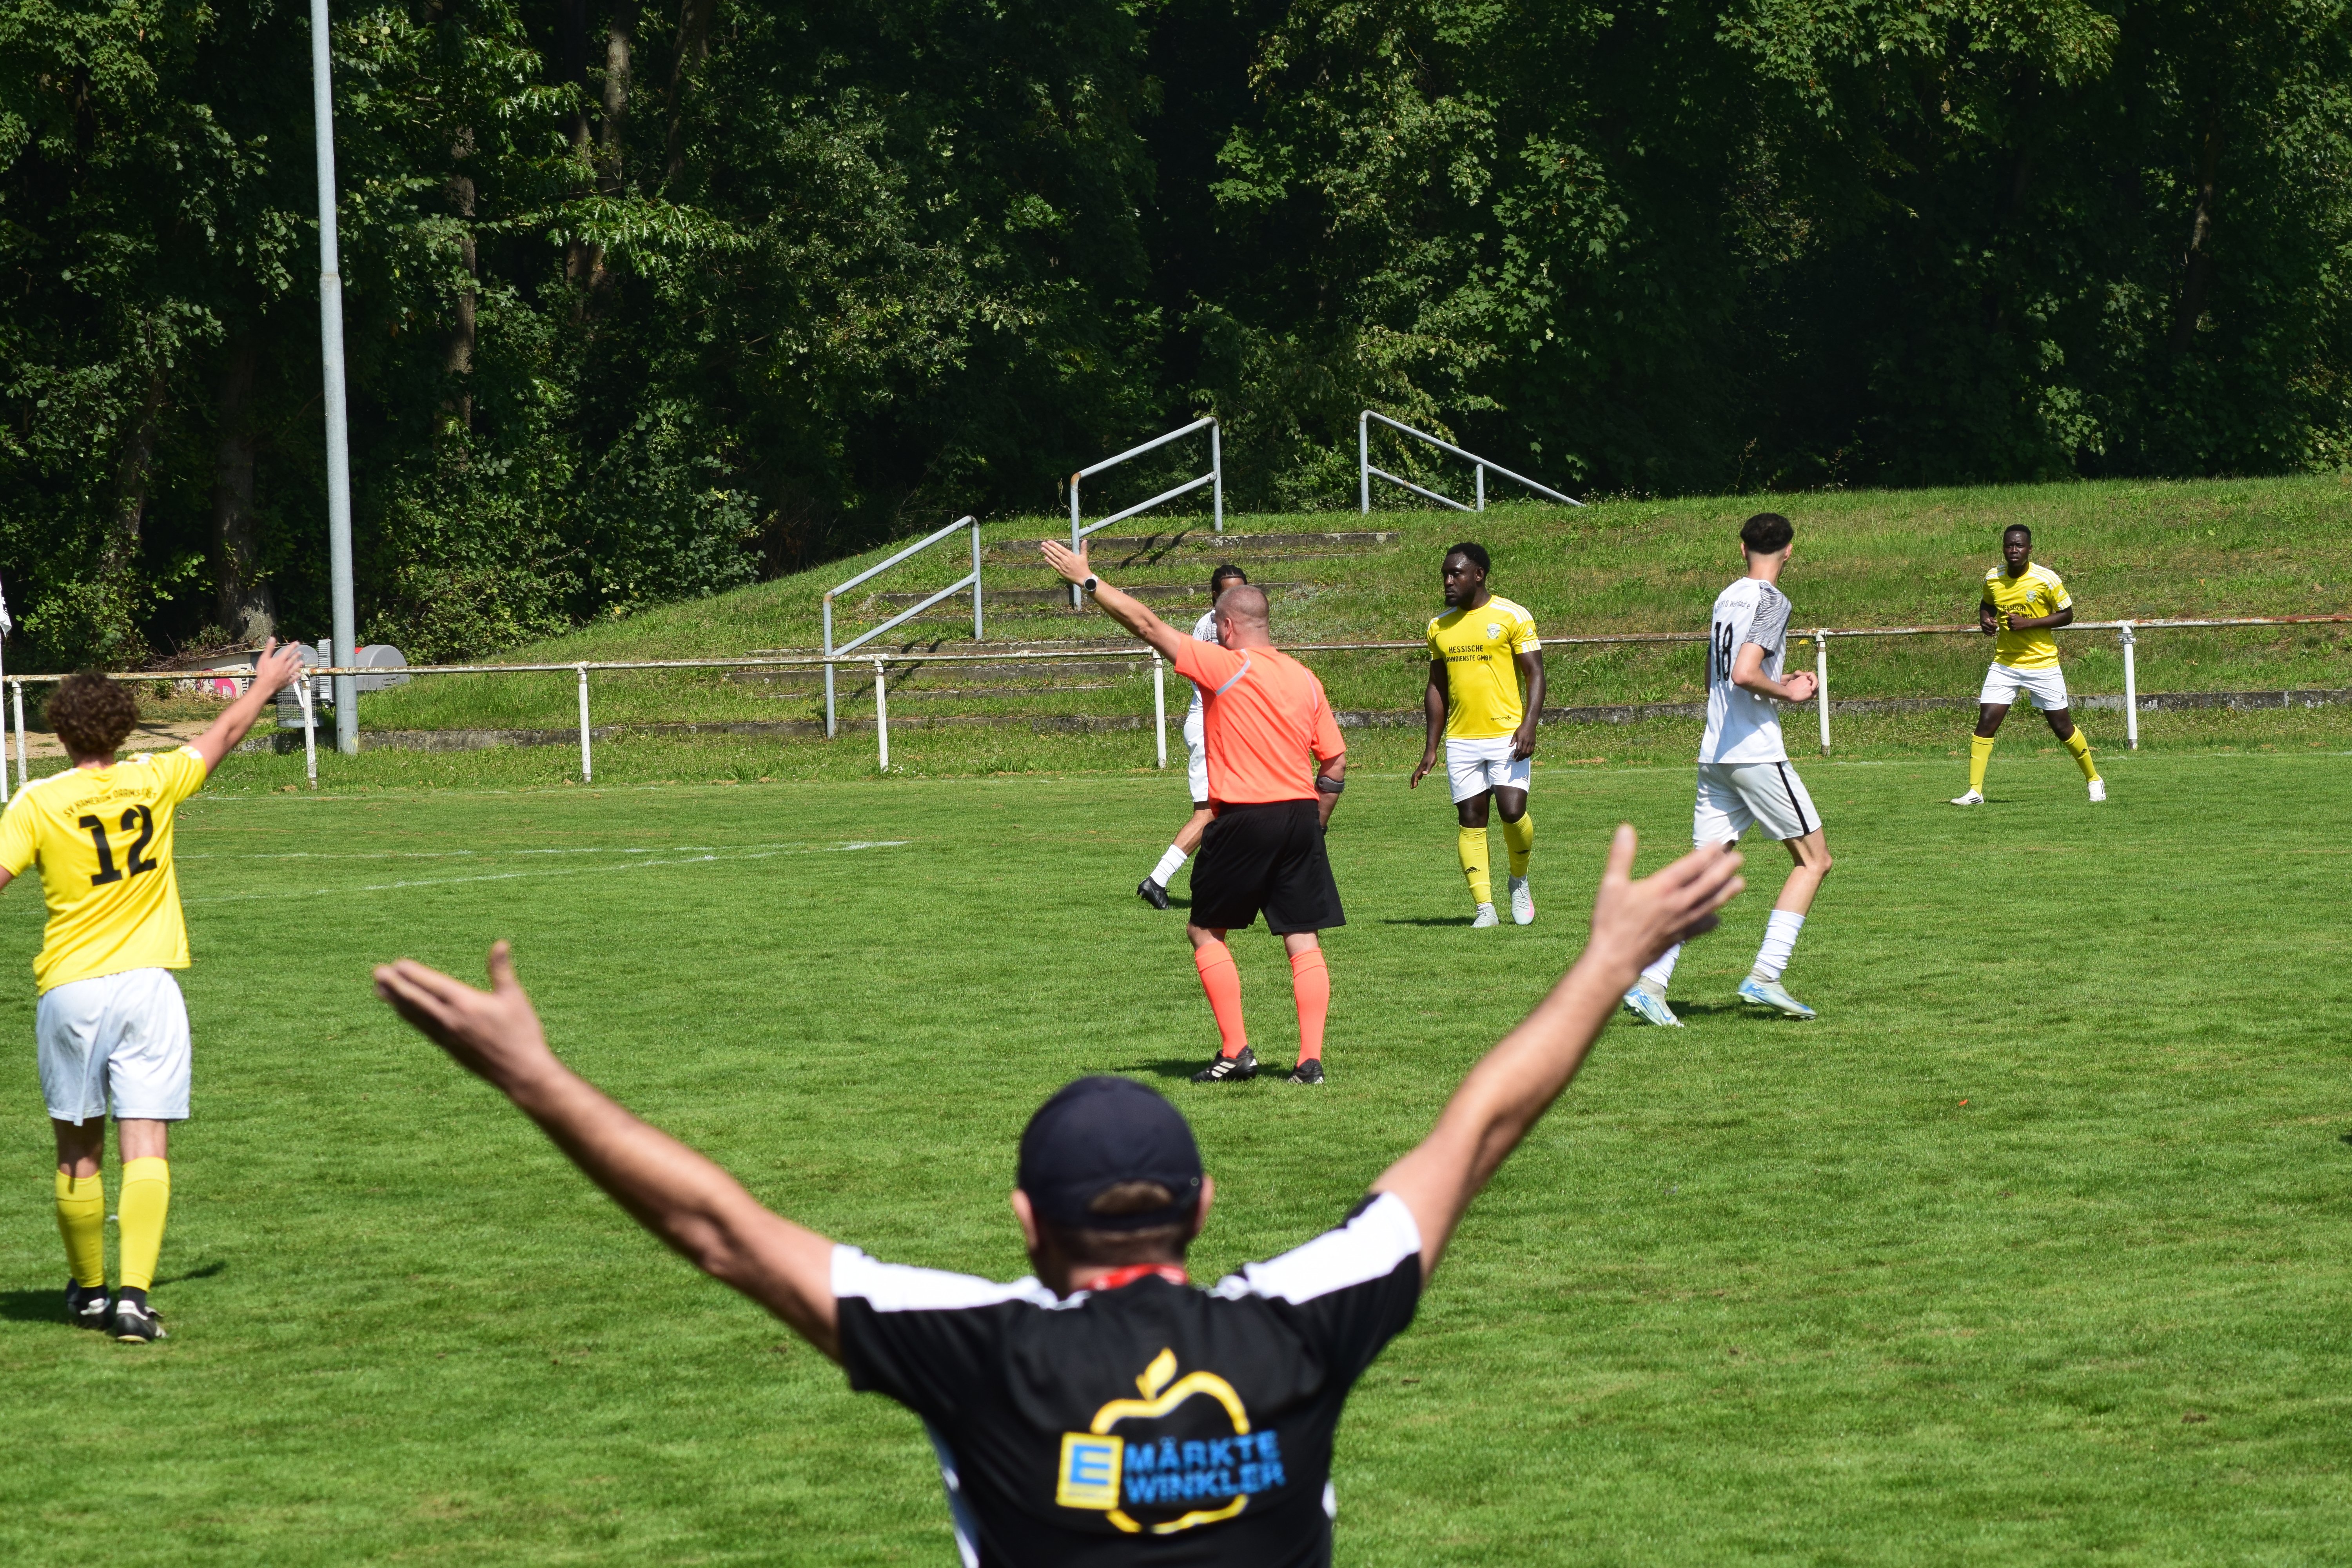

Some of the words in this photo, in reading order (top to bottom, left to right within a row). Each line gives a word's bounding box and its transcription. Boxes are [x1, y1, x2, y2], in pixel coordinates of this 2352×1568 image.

[1448, 645, 1484, 653] HESSISCHE
[1715, 621, 1733, 681] 18
[79, 804, 157, 886] 12
[1123, 1430, 1280, 1474] MÄRKTE
[1124, 1461, 1286, 1504] WINKLER
